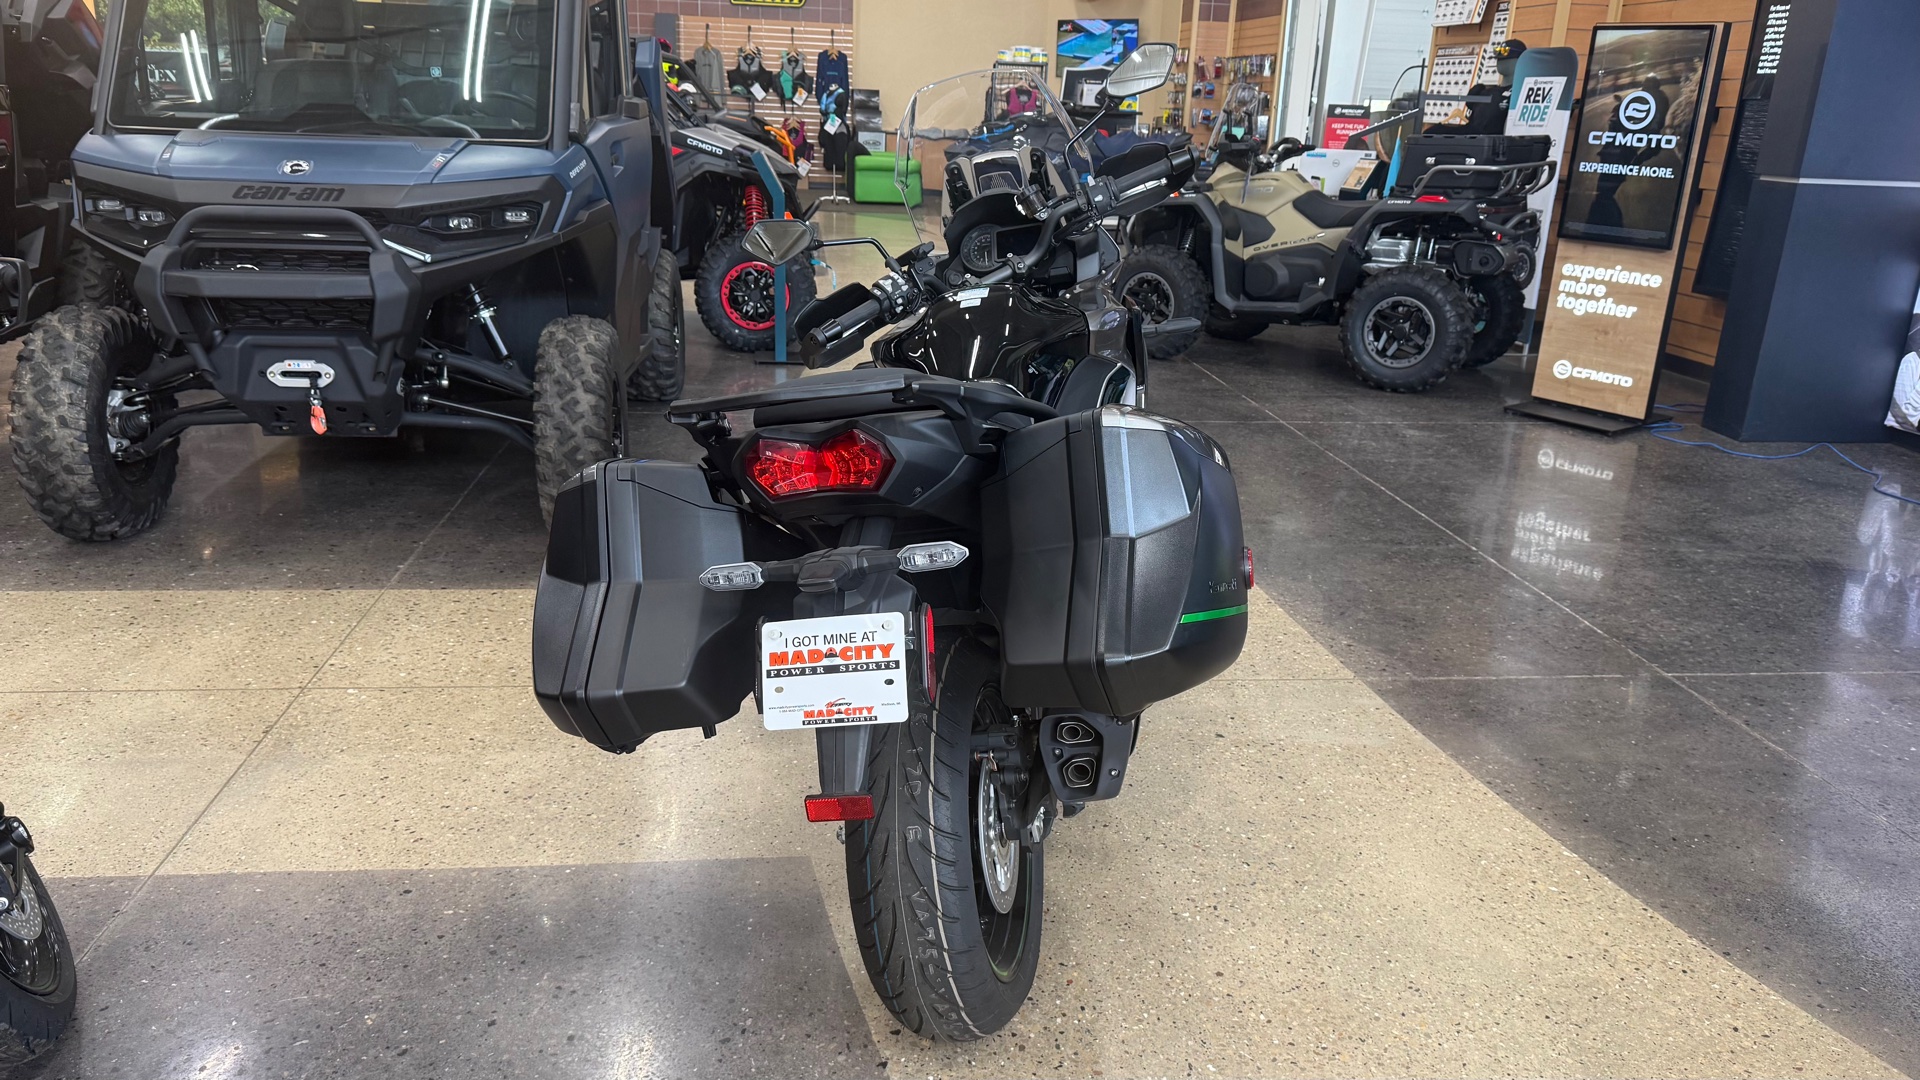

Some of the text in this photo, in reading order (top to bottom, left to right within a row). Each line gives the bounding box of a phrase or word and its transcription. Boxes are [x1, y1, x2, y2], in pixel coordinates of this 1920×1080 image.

[1524, 87, 1553, 104] REV
[1518, 104, 1550, 127] RIDE
[687, 138, 723, 155] CFMOTO
[1588, 131, 1678, 149] CFMOTO
[1579, 162, 1675, 179] EXPERIENCE MORE.
[232, 185, 345, 202] can-am
[1562, 263, 1663, 288] experience
[1558, 279, 1606, 297] more
[1556, 293, 1637, 318] together
[1572, 367, 1633, 387] CFMOTO
[785, 631, 878, 648] I GOT MINE AT
[769, 643, 895, 667] MAD CITY
[770, 661, 896, 677] POWER SPORTS
[803, 706, 875, 719] MAD CITY
